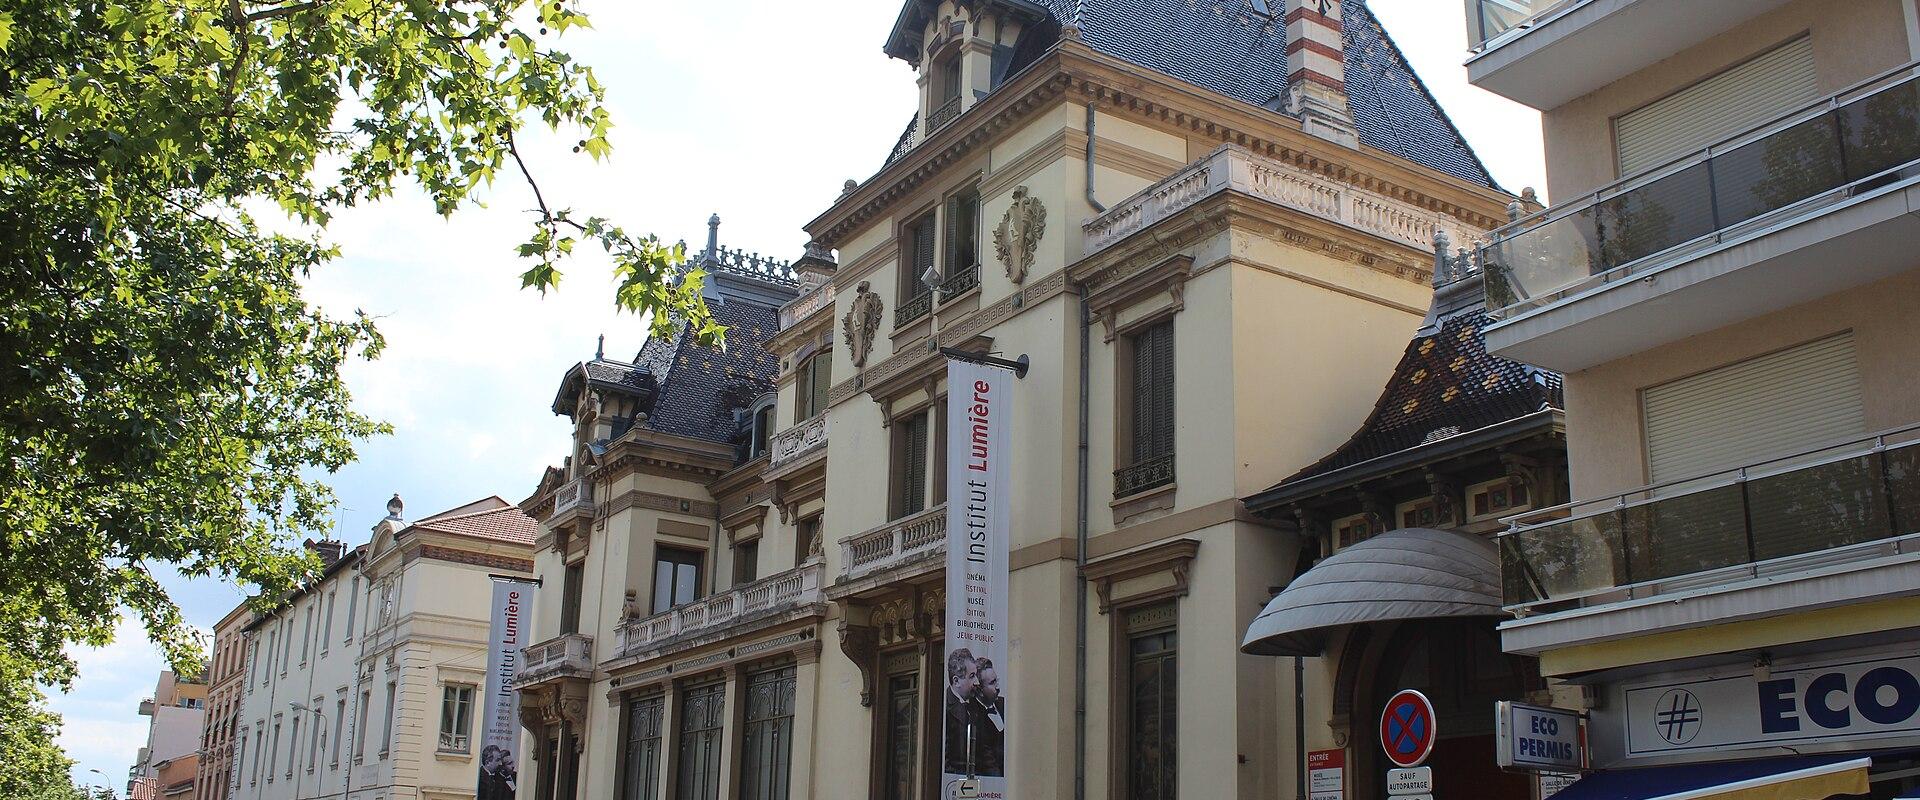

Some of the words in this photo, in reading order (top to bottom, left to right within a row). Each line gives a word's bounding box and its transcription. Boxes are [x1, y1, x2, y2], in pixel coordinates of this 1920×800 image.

[968, 380, 990, 472] Lumière
[967, 479, 987, 563] Institut
[503, 591, 520, 645] Lumière
[498, 649, 515, 697] Institut
[1757, 667, 1920, 734] ECO
[1531, 715, 1558, 736] ECO
[1309, 753, 1329, 761] ENTRÉE
[1519, 737, 1573, 760] PERMIS
[1389, 781, 1428, 791] AUTOPARTAGE
[1399, 772, 1416, 780] SAUF
